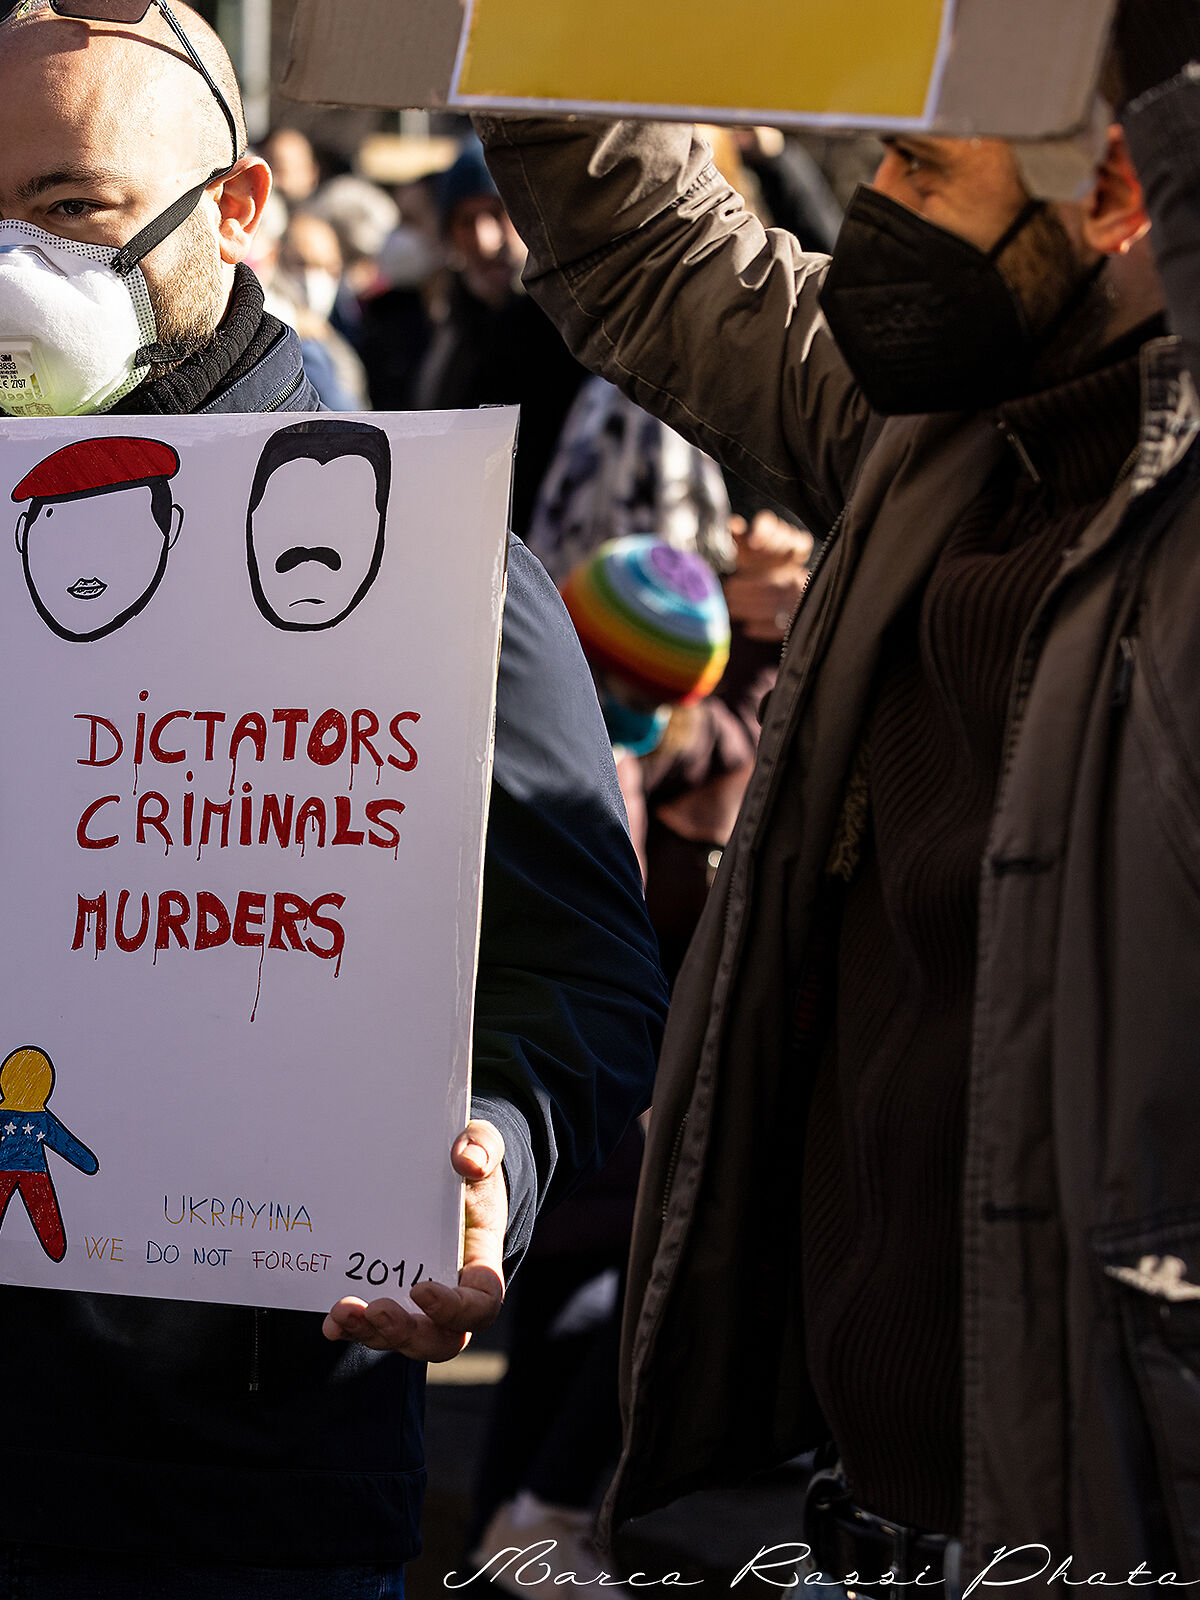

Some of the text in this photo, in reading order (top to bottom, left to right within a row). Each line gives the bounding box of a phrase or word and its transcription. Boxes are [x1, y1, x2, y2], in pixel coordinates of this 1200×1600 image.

[0, 354, 12, 362] 3M
[10, 379, 26, 388] 2797
[71, 890, 347, 974] MURDERS
[163, 1194, 314, 1233] UKRAYINA
[84, 1236, 125, 1263] WE
[146, 1240, 180, 1265] DO
[193, 1246, 233, 1267] NOT
[252, 1250, 332, 1273] FORGET
